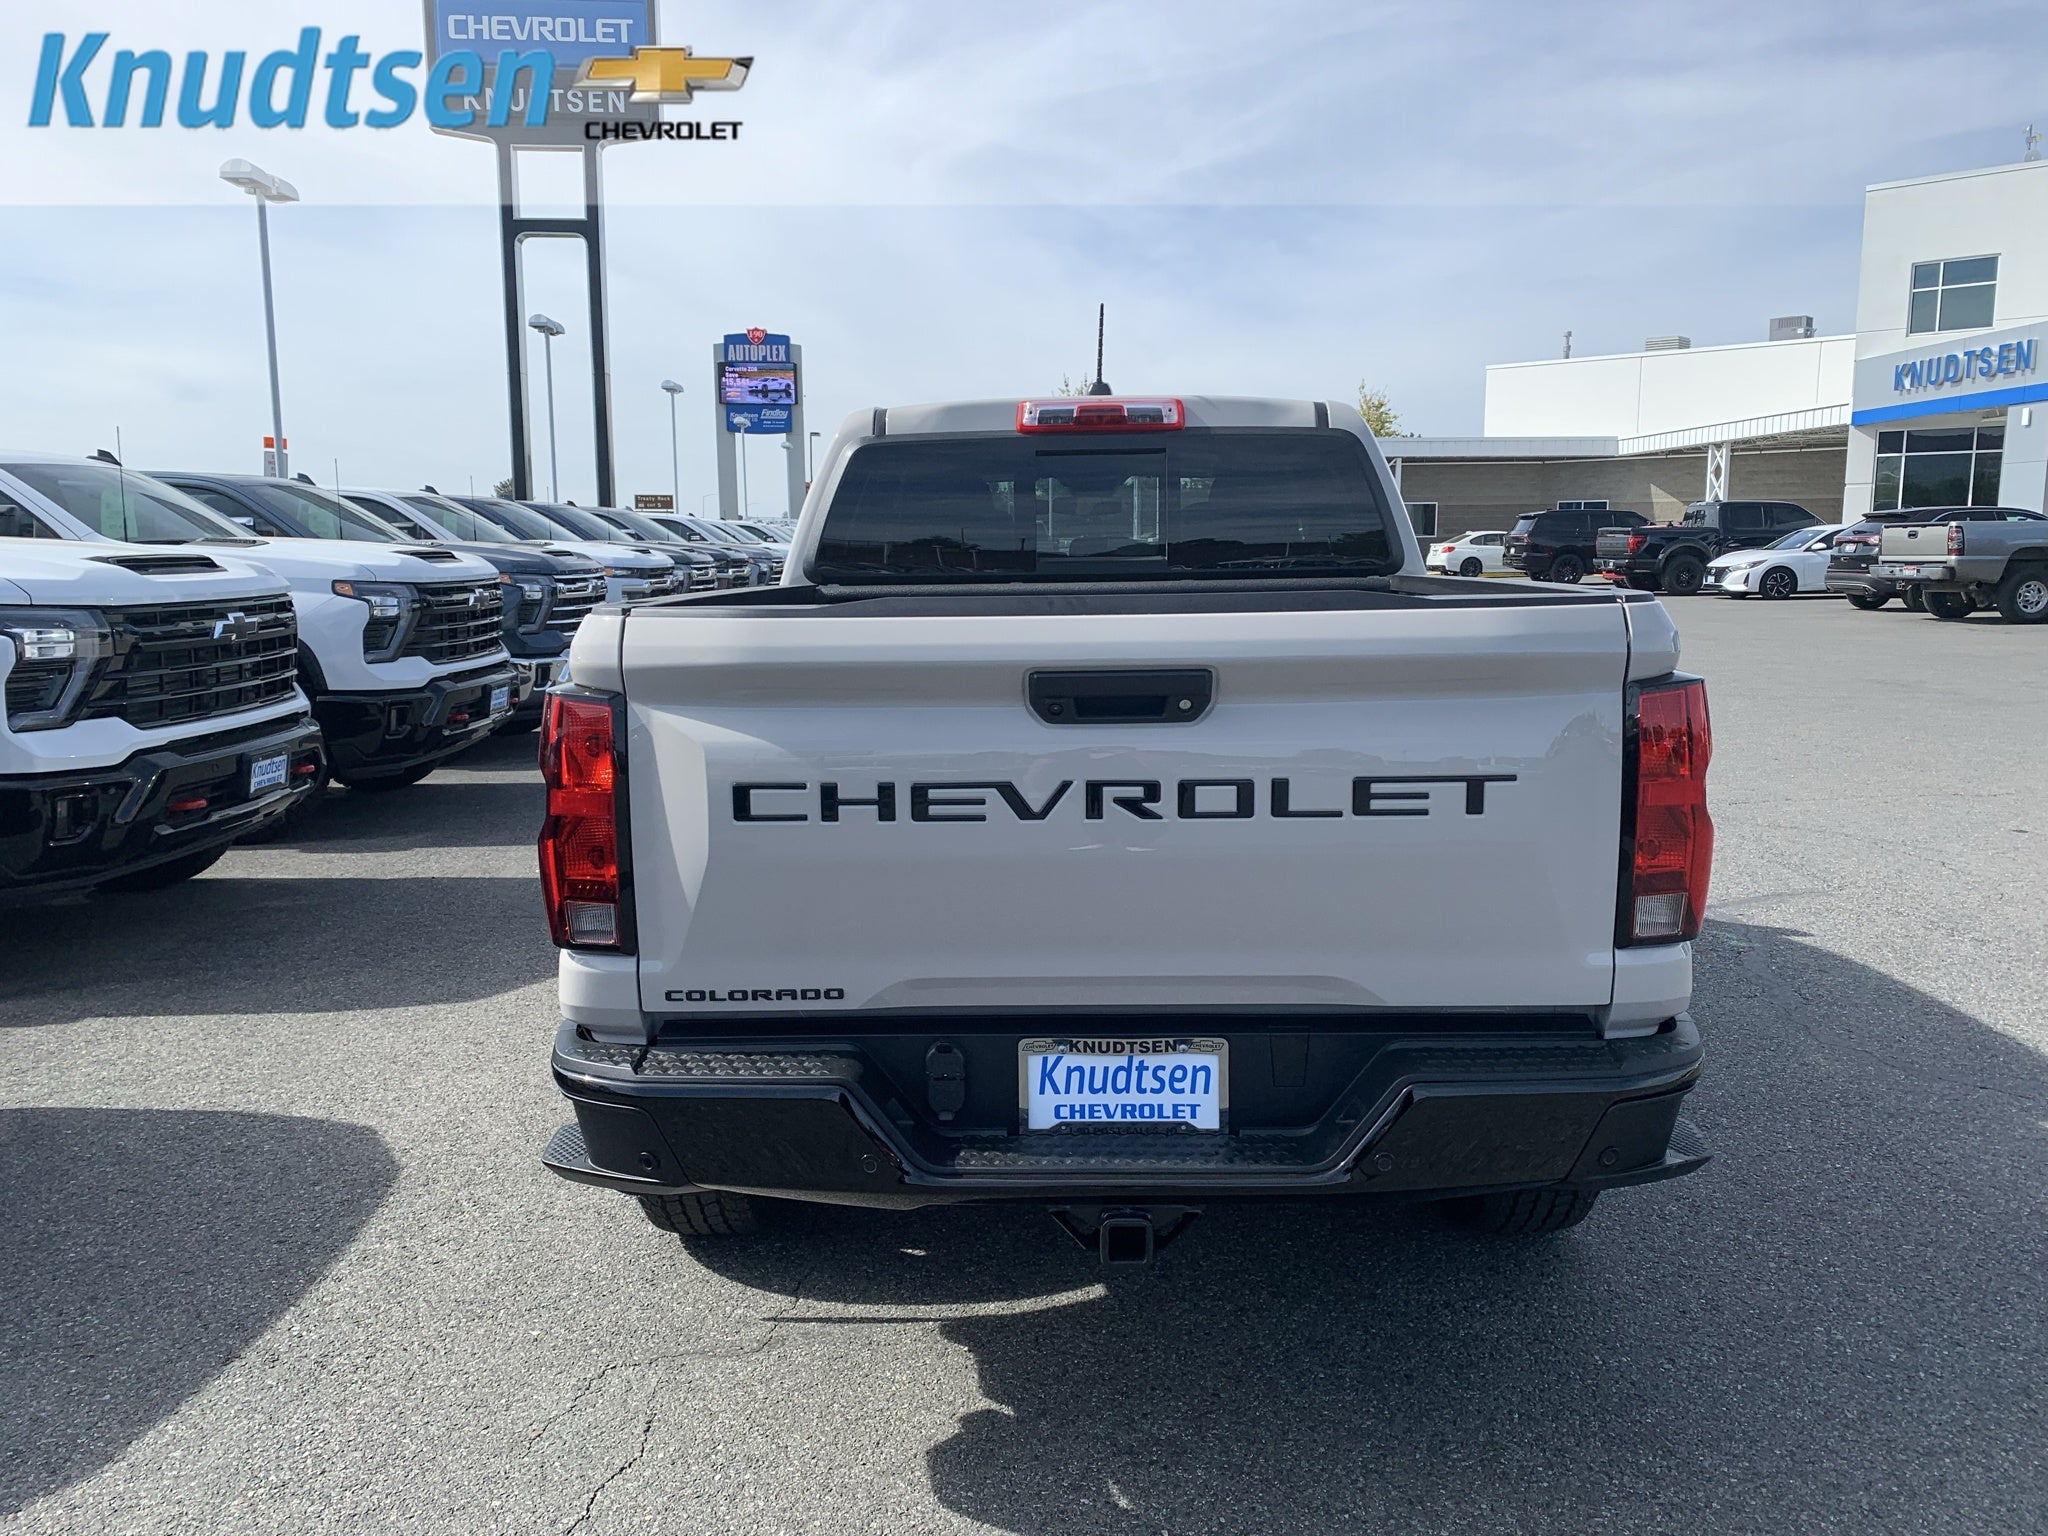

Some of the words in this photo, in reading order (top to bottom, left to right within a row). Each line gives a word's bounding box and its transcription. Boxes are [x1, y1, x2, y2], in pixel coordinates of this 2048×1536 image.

[447, 14, 633, 43] CHEVROLET
[463, 87, 625, 113] KNUTSEN
[728, 344, 786, 361] AUTOPLEX
[1893, 338, 2036, 391] KNUDTSEN
[252, 758, 286, 779] Knudtsen
[731, 773, 1518, 824] CHEVROLET
[664, 988, 844, 1002] COLORADO
[1068, 1039, 1177, 1053] KNUDTSEN
[1038, 1055, 1212, 1096] Knudtsen
[1054, 1103, 1201, 1120] CHEVROLET
